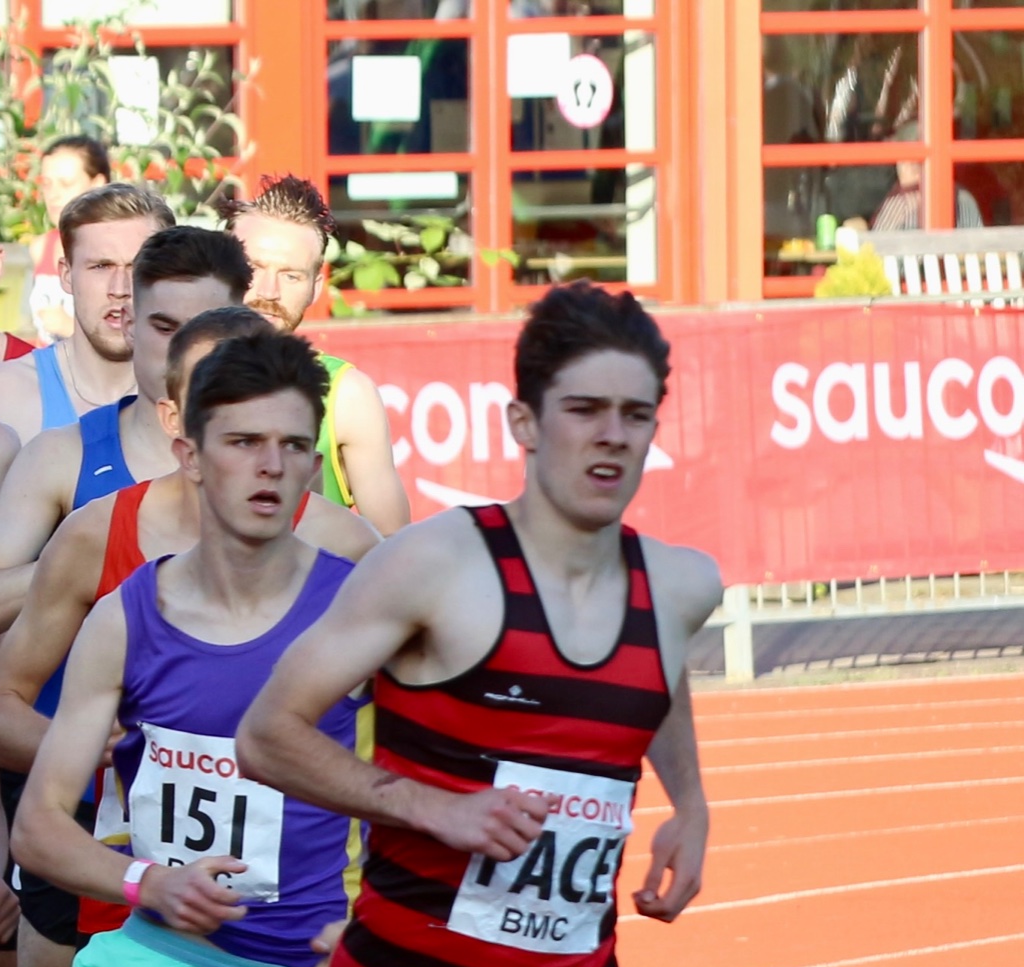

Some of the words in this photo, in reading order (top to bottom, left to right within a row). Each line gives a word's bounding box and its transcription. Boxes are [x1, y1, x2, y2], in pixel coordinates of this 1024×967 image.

[149, 740, 244, 779] sauco
[160, 783, 247, 859] 151
[499, 907, 569, 942] BMC
